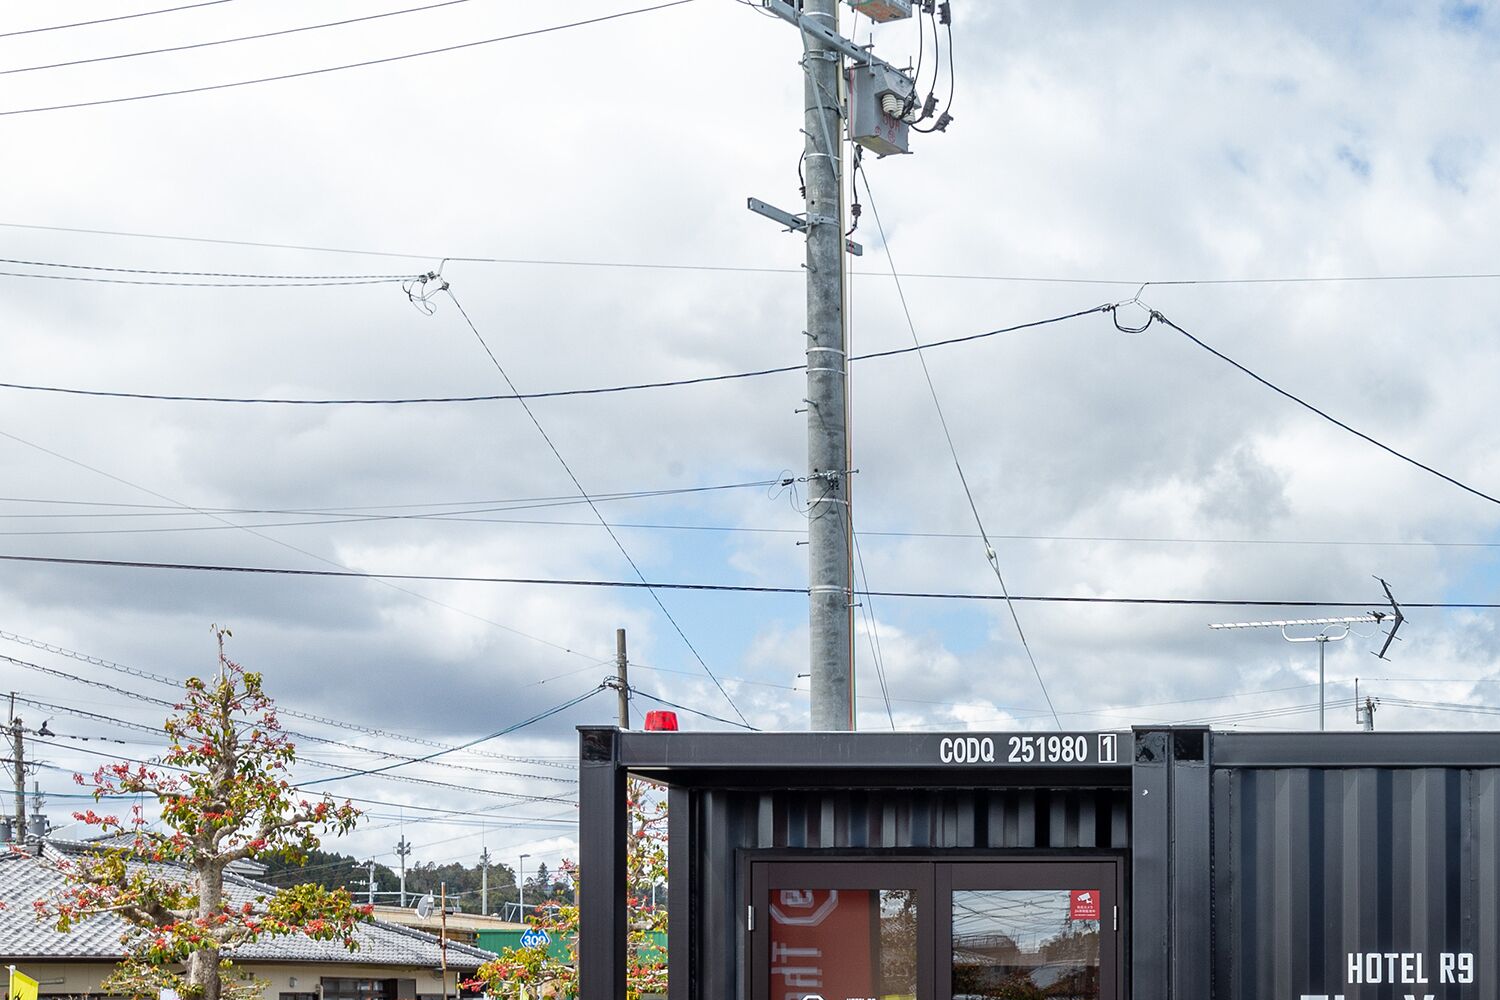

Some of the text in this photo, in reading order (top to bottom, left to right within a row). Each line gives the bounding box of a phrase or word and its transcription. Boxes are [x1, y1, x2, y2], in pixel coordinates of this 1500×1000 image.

[940, 735, 1114, 763] CODQ 251980 1
[1347, 953, 1473, 983] HOTEL R9
